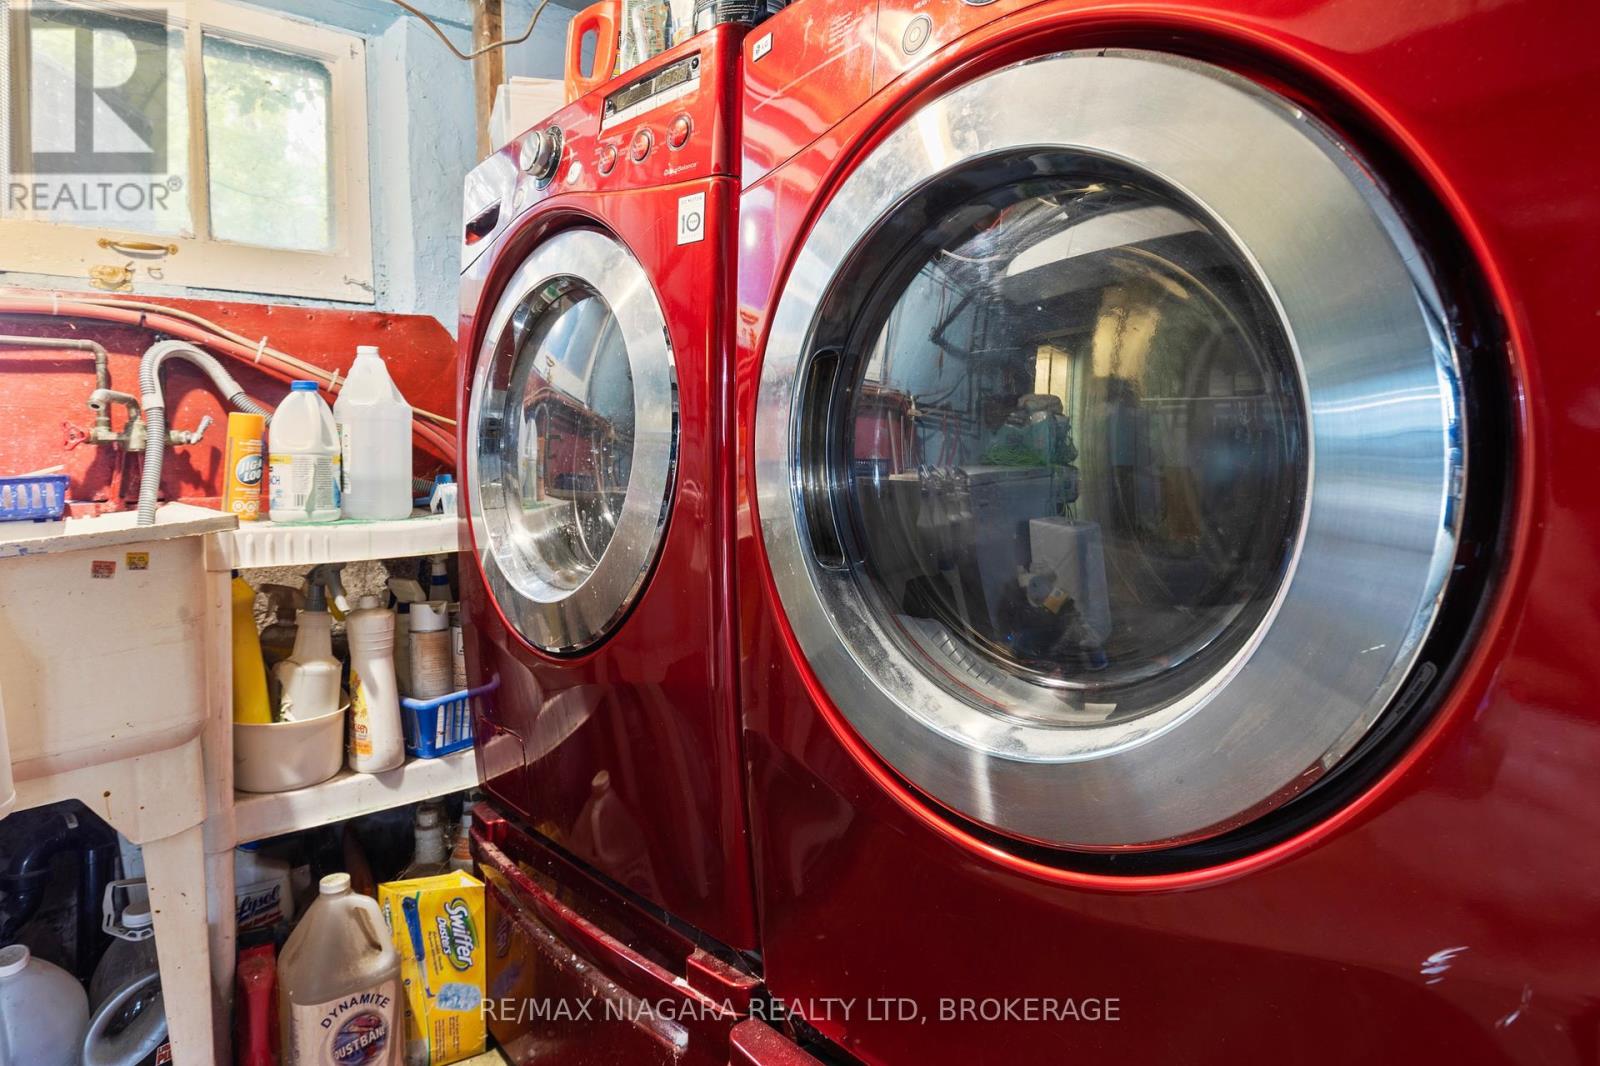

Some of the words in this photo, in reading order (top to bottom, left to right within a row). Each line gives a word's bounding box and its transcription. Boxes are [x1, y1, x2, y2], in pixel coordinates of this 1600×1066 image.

[437, 917, 451, 954] Dusters
[445, 901, 472, 970] Swiffer
[321, 993, 390, 1028] DYNAMITE
